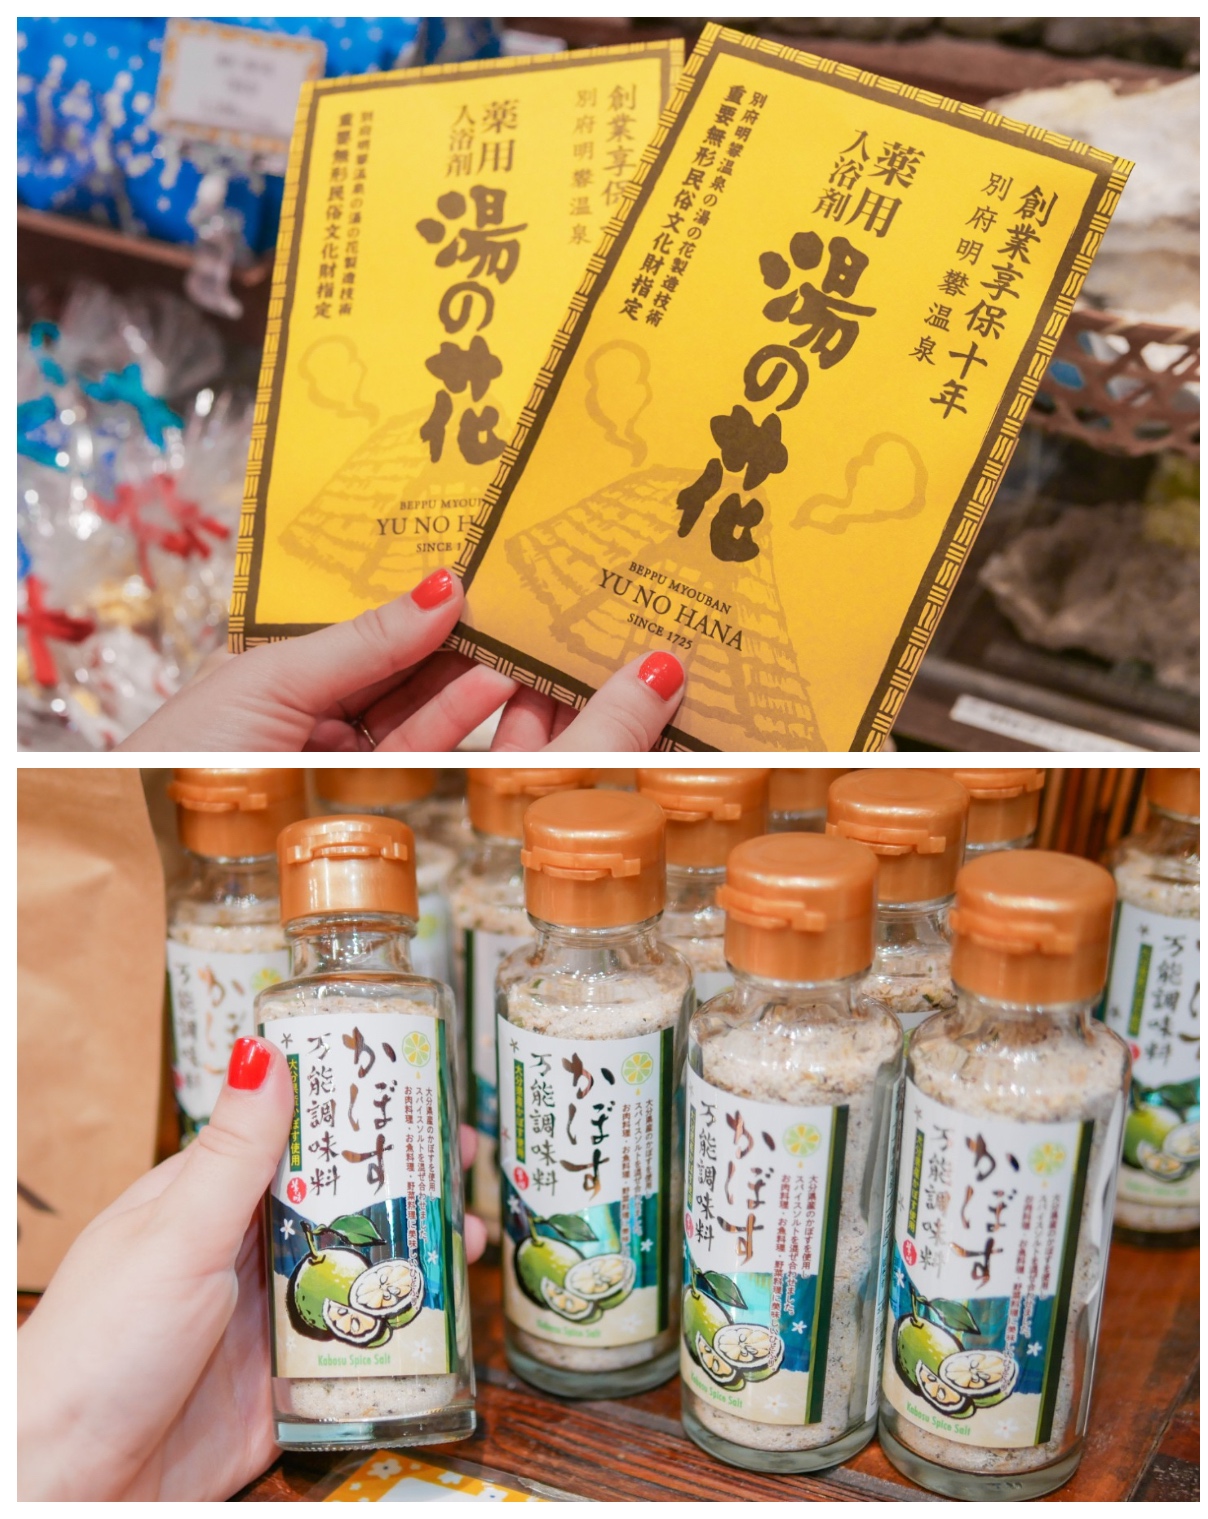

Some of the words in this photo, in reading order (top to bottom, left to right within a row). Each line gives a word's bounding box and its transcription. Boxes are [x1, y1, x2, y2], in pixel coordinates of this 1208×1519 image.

[446, 105, 476, 178] 入浴剤
[479, 99, 520, 174] 薬用
[812, 129, 872, 223] 入浴剤
[619, 84, 748, 322] 重要無形民俗文化財指定
[845, 141, 926, 239] 薬用
[416, 184, 528, 465] 湯の花
[929, 185, 1059, 420] 創業享保十年
[677, 231, 877, 562] 湯の花
[377, 517, 407, 536] YU
[414, 516, 449, 534] NO
[400, 500, 437, 511] BEPPU
[416, 543, 453, 553] SINCE
[598, 568, 629, 597] YU
[633, 584, 673, 615] NO
[674, 601, 744, 652] HANA
[627, 613, 665, 638] SINCE
[666, 628, 693, 650] 1725
[629, 562, 667, 587] BEPPU
[668, 579, 732, 615] MYOUBAN
[307, 1033, 340, 1196] 万能調味料
[342, 1026, 397, 1195] かぼす
[529, 1053, 557, 1196] 万能調味料
[560, 1052, 615, 1201] かぼす
[695, 1101, 717, 1252] 万能調味料
[717, 1110, 775, 1266] かぼす
[950, 1133, 1020, 1291] かぼす
[318, 1355, 347, 1366] Kabosu
[349, 1354, 372, 1368] Spice
[374, 1353, 391, 1365] Salt
[906, 1403, 930, 1423] Kabosu
[932, 1417, 952, 1431] Spice
[954, 1422, 971, 1436] Salt
